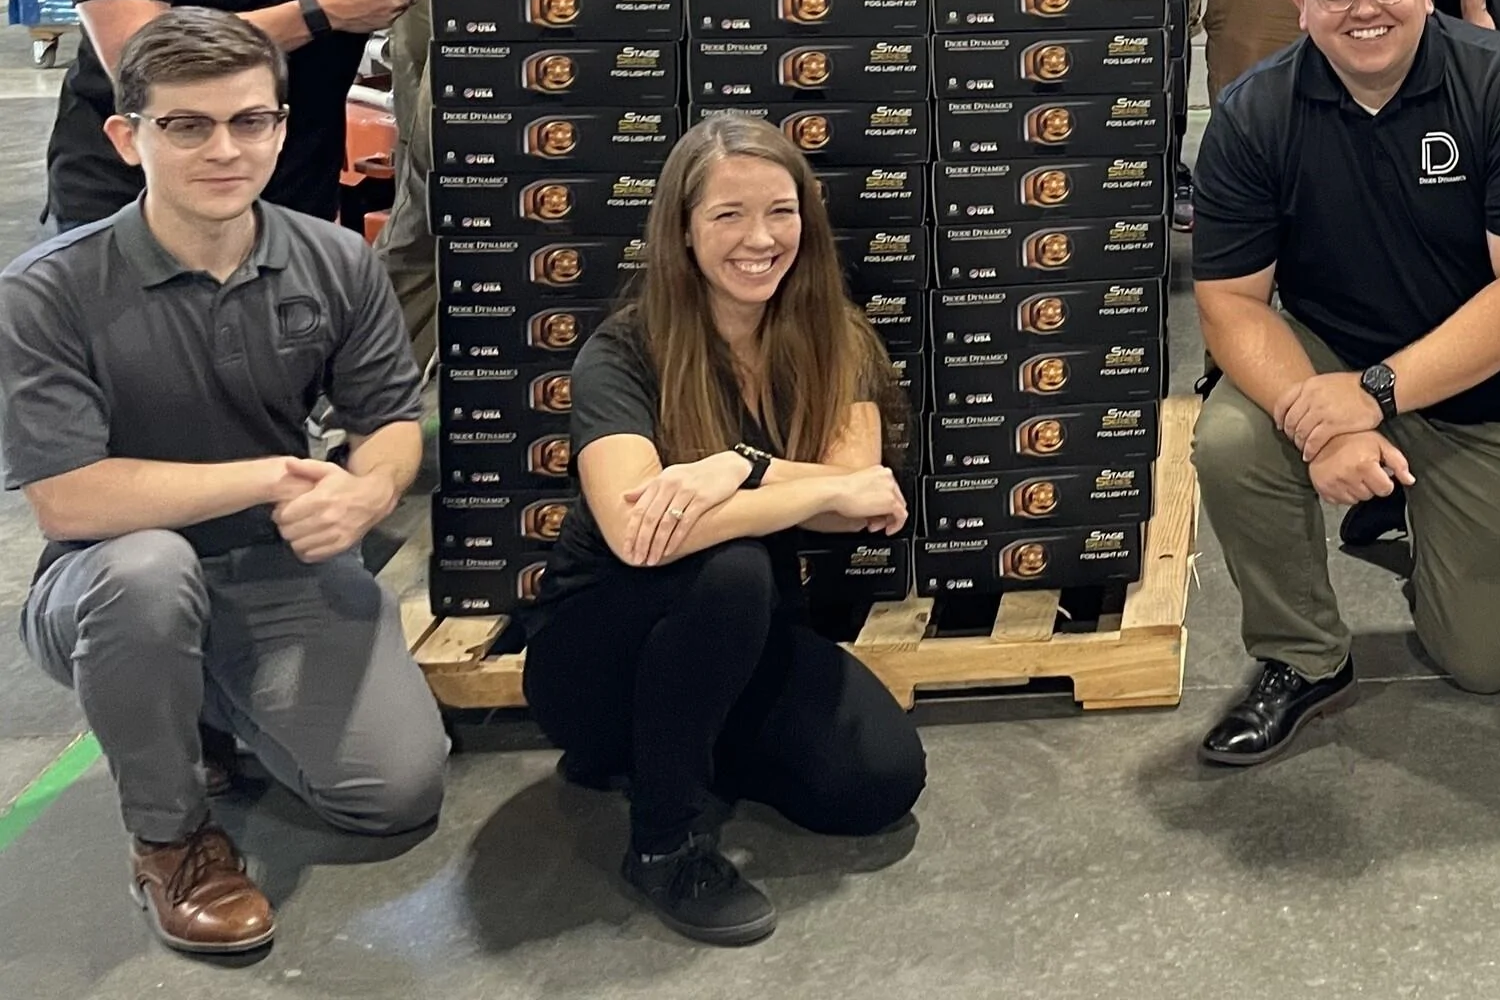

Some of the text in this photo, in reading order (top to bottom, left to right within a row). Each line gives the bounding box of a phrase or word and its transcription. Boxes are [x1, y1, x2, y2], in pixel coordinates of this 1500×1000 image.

[977, 16, 994, 24] USA
[478, 25, 496, 33] USA
[732, 21, 750, 30] USA
[1111, 345, 1144, 357] STAGE
[976, 395, 993, 404] USA
